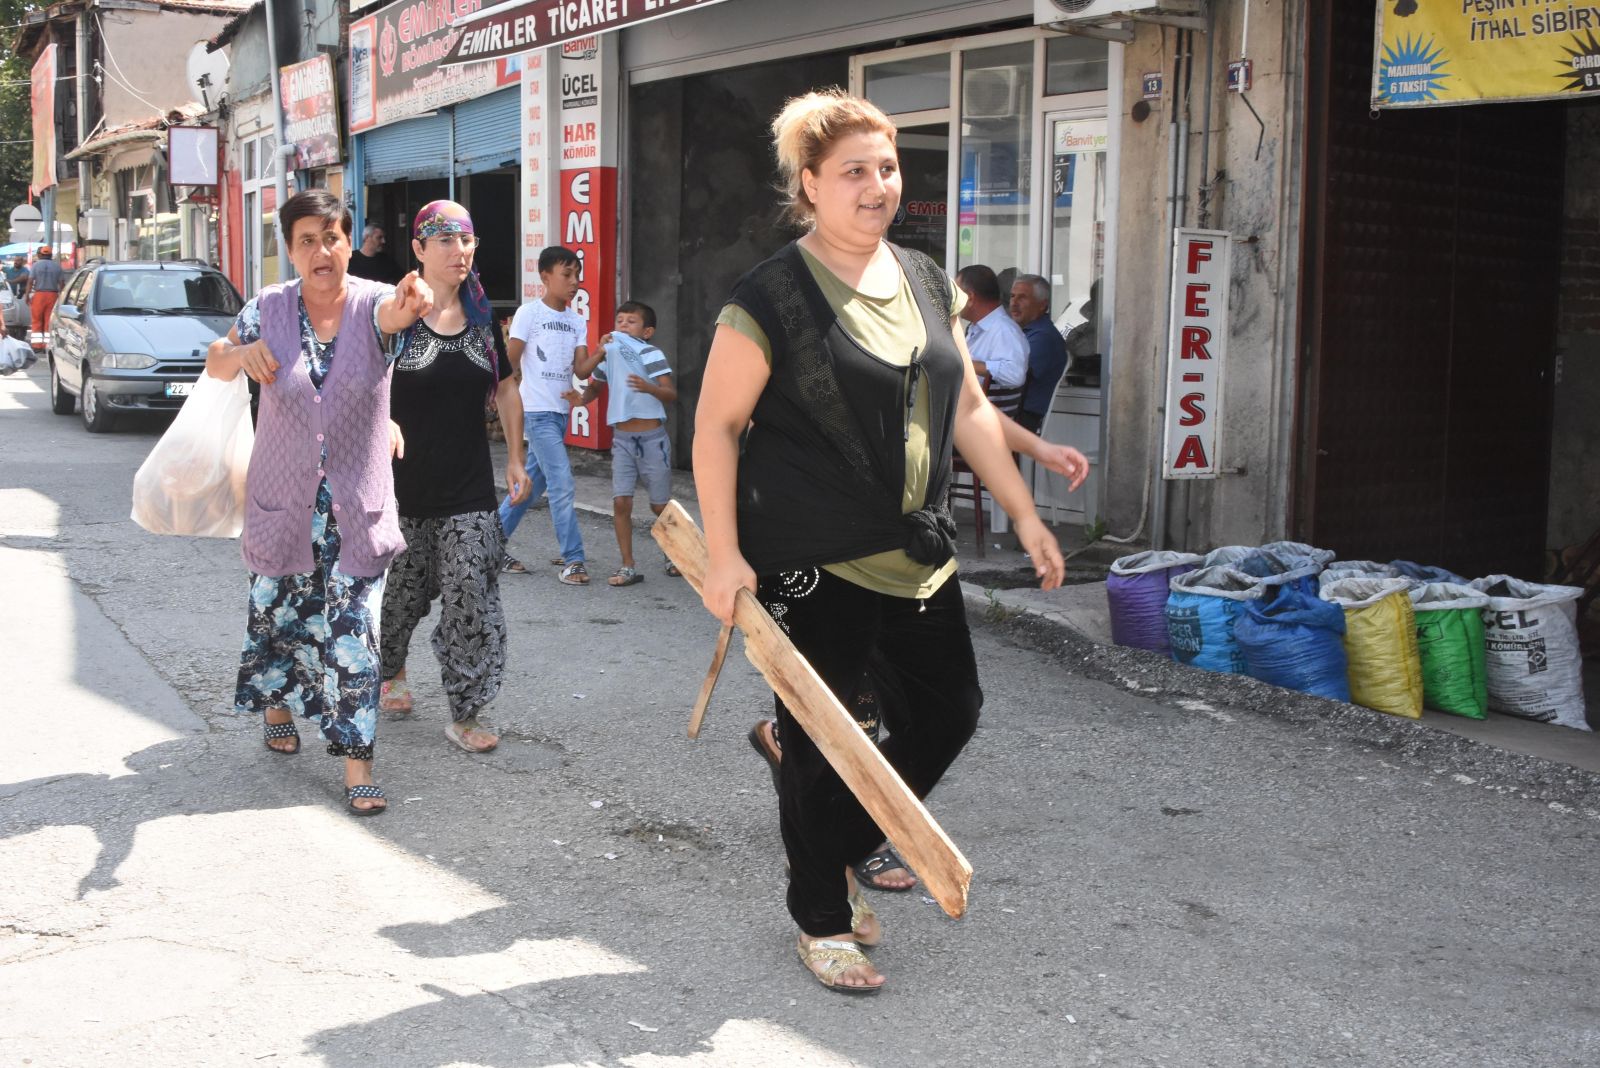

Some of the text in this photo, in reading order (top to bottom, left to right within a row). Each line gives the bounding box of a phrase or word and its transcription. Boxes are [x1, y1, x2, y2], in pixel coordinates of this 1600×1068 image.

[458, 0, 629, 56] EMİRLER TİCARET
[1470, 18, 1526, 41] İTHAL
[1387, 63, 1431, 78] MAXIMUM
[562, 74, 598, 96] ÜÇEL
[1147, 80, 1158, 92] 13
[1390, 80, 1428, 93] 6 TAKSİT
[1585, 73, 1594, 87] 6
[564, 122, 596, 143] HAR
[1065, 134, 1093, 148] Banvit
[563, 145, 596, 160] KÖMÜR
[1174, 239, 1213, 468] FER-SA
